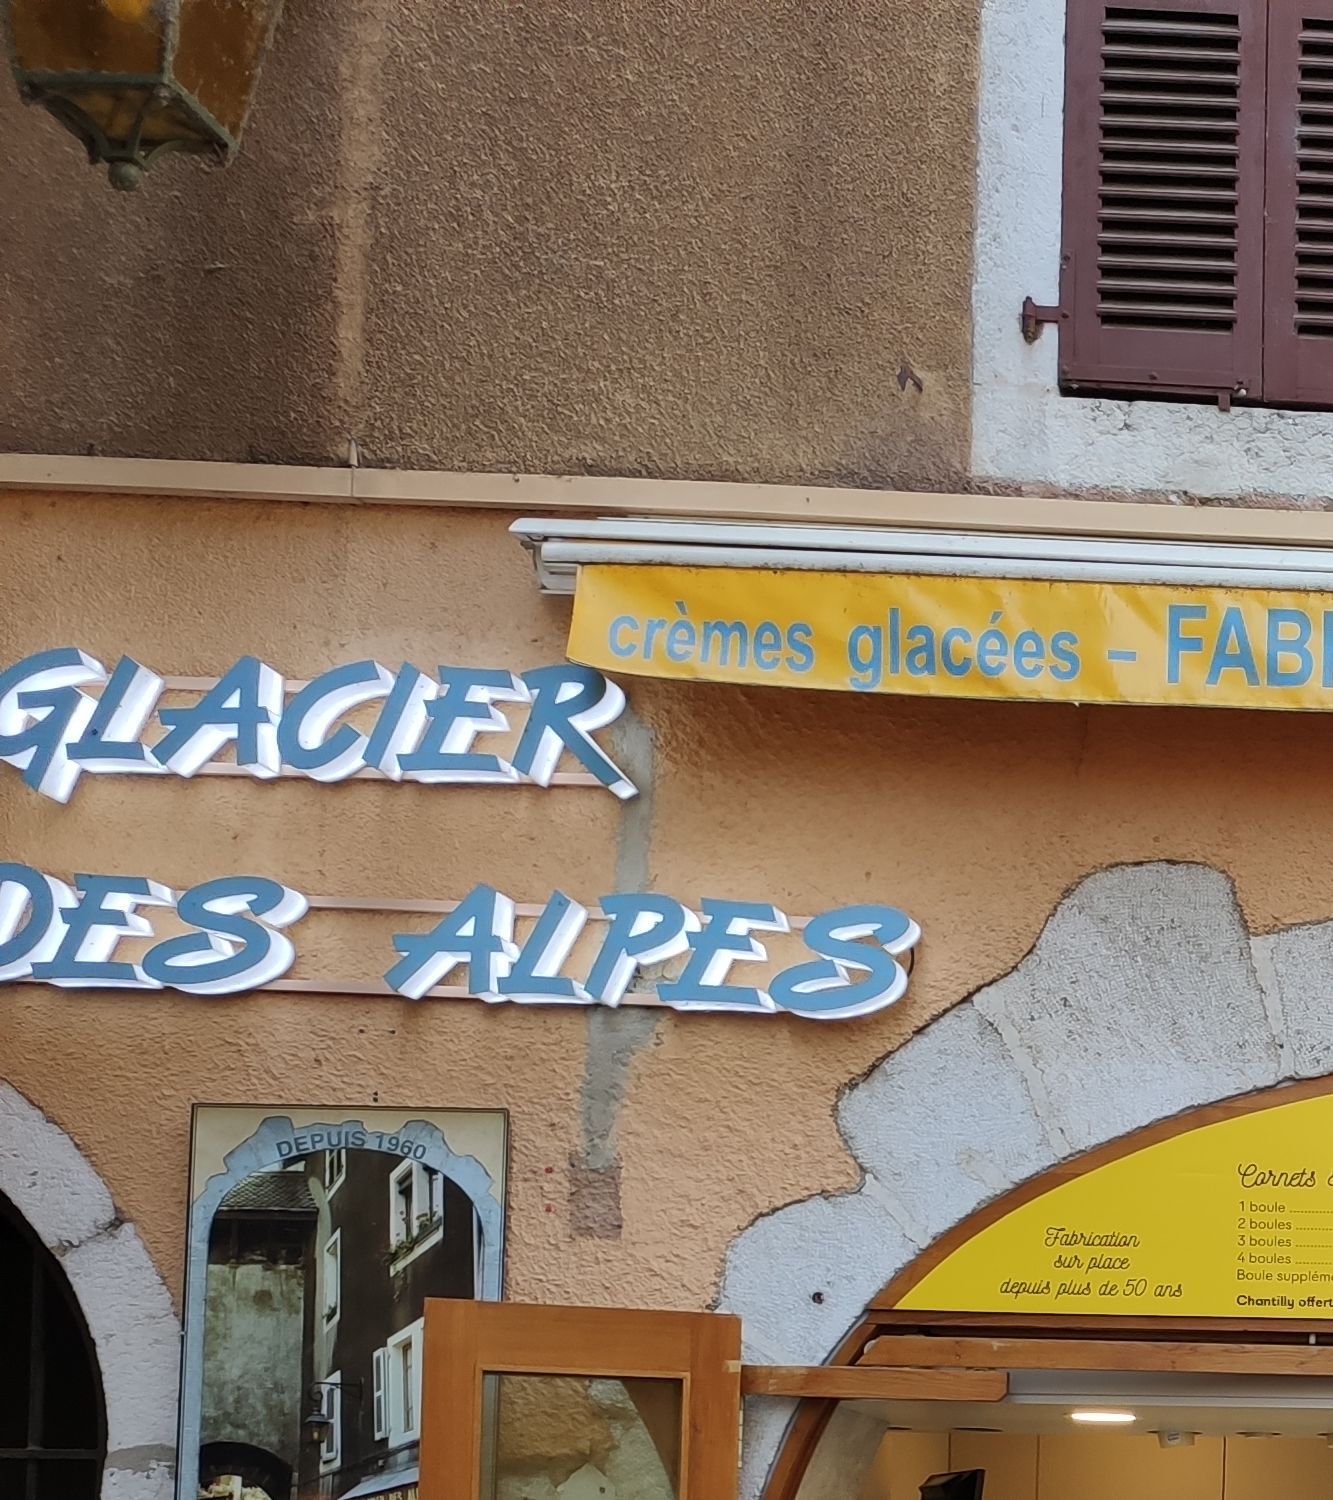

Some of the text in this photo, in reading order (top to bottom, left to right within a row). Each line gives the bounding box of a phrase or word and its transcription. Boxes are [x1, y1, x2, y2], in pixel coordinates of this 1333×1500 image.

[606, 600, 816, 672] crèmes
[846, 605, 1081, 692] glacées
[0, 647, 639, 802] GLACIER
[0, 862, 923, 1021] DES ALPES
[276, 1130, 428, 1161] DEPUIS 1960
[1237, 1163, 1316, 1188] Cornets
[1237, 1201, 1246, 1213] 1
[1249, 1201, 1286, 1213] boule
[1237, 1218, 1246, 1230] 2
[1249, 1218, 1292, 1230] boules
[1044, 1226, 1141, 1248] Fabrication
[1237, 1235, 1246, 1247] 3
[1249, 1235, 1292, 1247] boules
[1053, 1253, 1131, 1275] sur place
[1237, 1252, 1246, 1264] 4
[1249, 1252, 1292, 1264] boules
[1236, 1268, 1273, 1281] Boule
[1000, 1278, 1183, 1300] depuis plus de 50 ans
[1236, 1294, 1295, 1309] Chantilly
